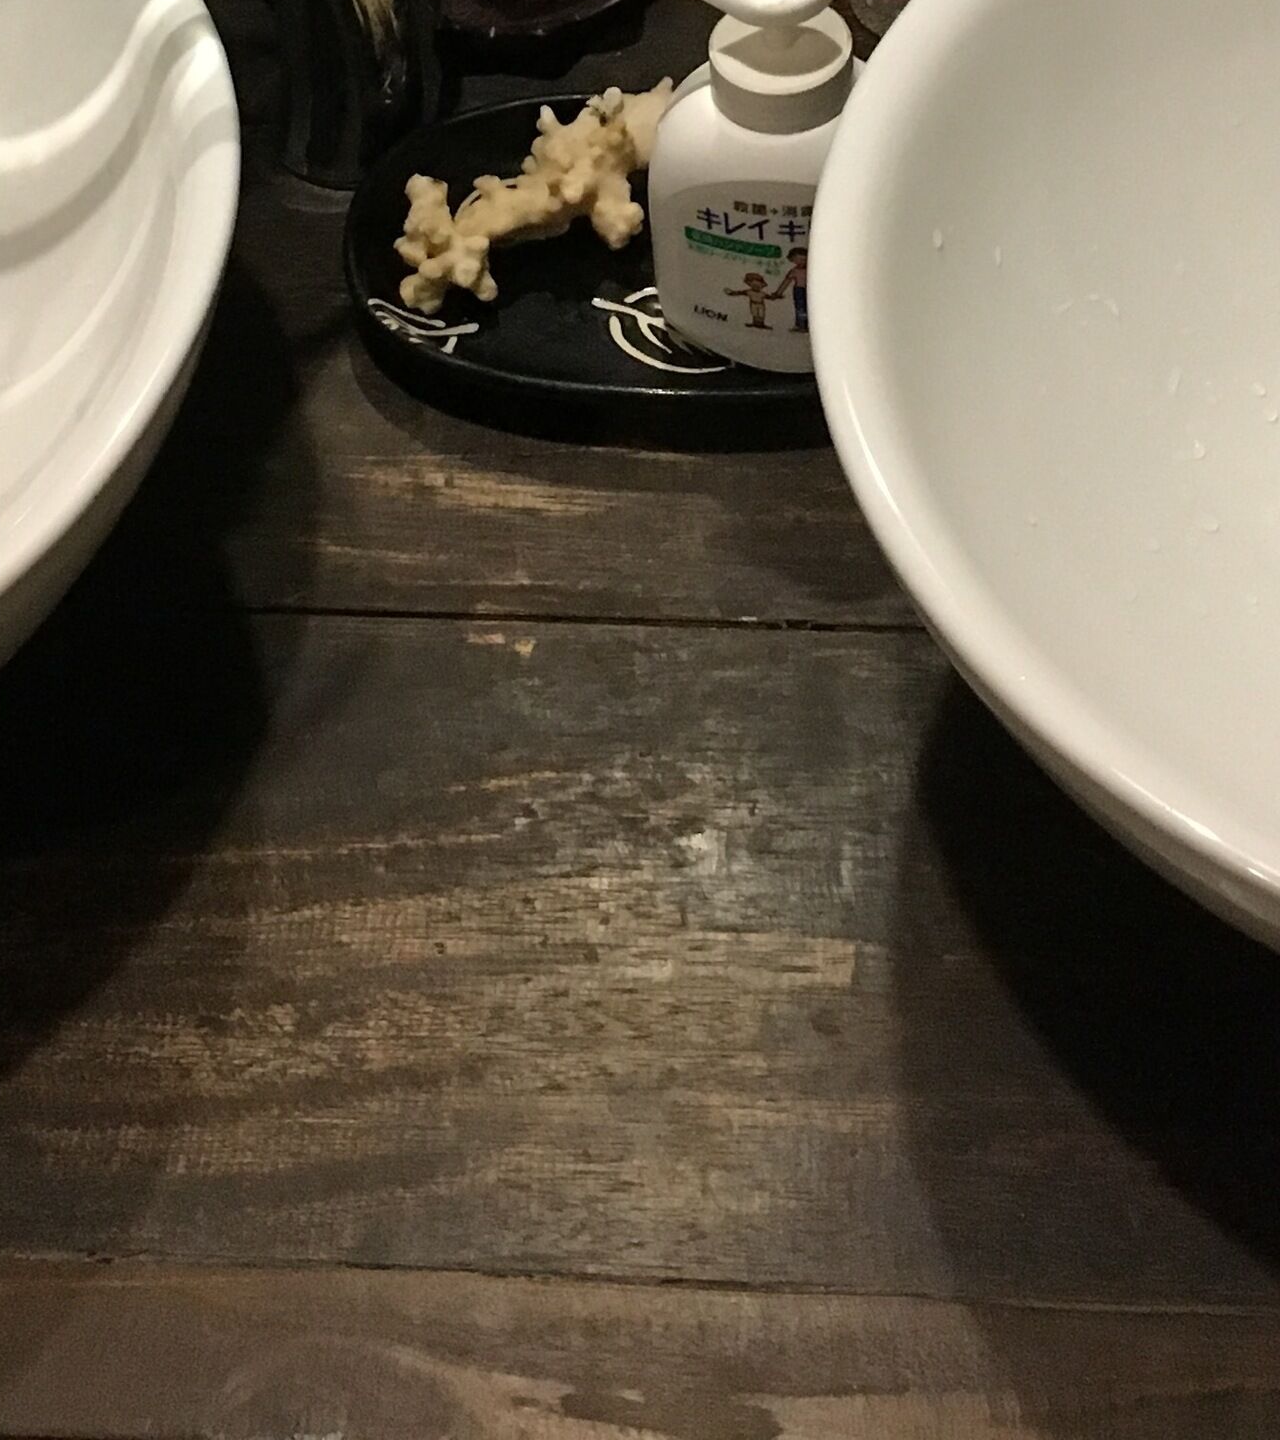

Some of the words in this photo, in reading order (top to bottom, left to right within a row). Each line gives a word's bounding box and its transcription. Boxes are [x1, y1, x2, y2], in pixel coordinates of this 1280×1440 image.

[696, 207, 813, 243] キレイキ
[693, 304, 729, 322] LION
